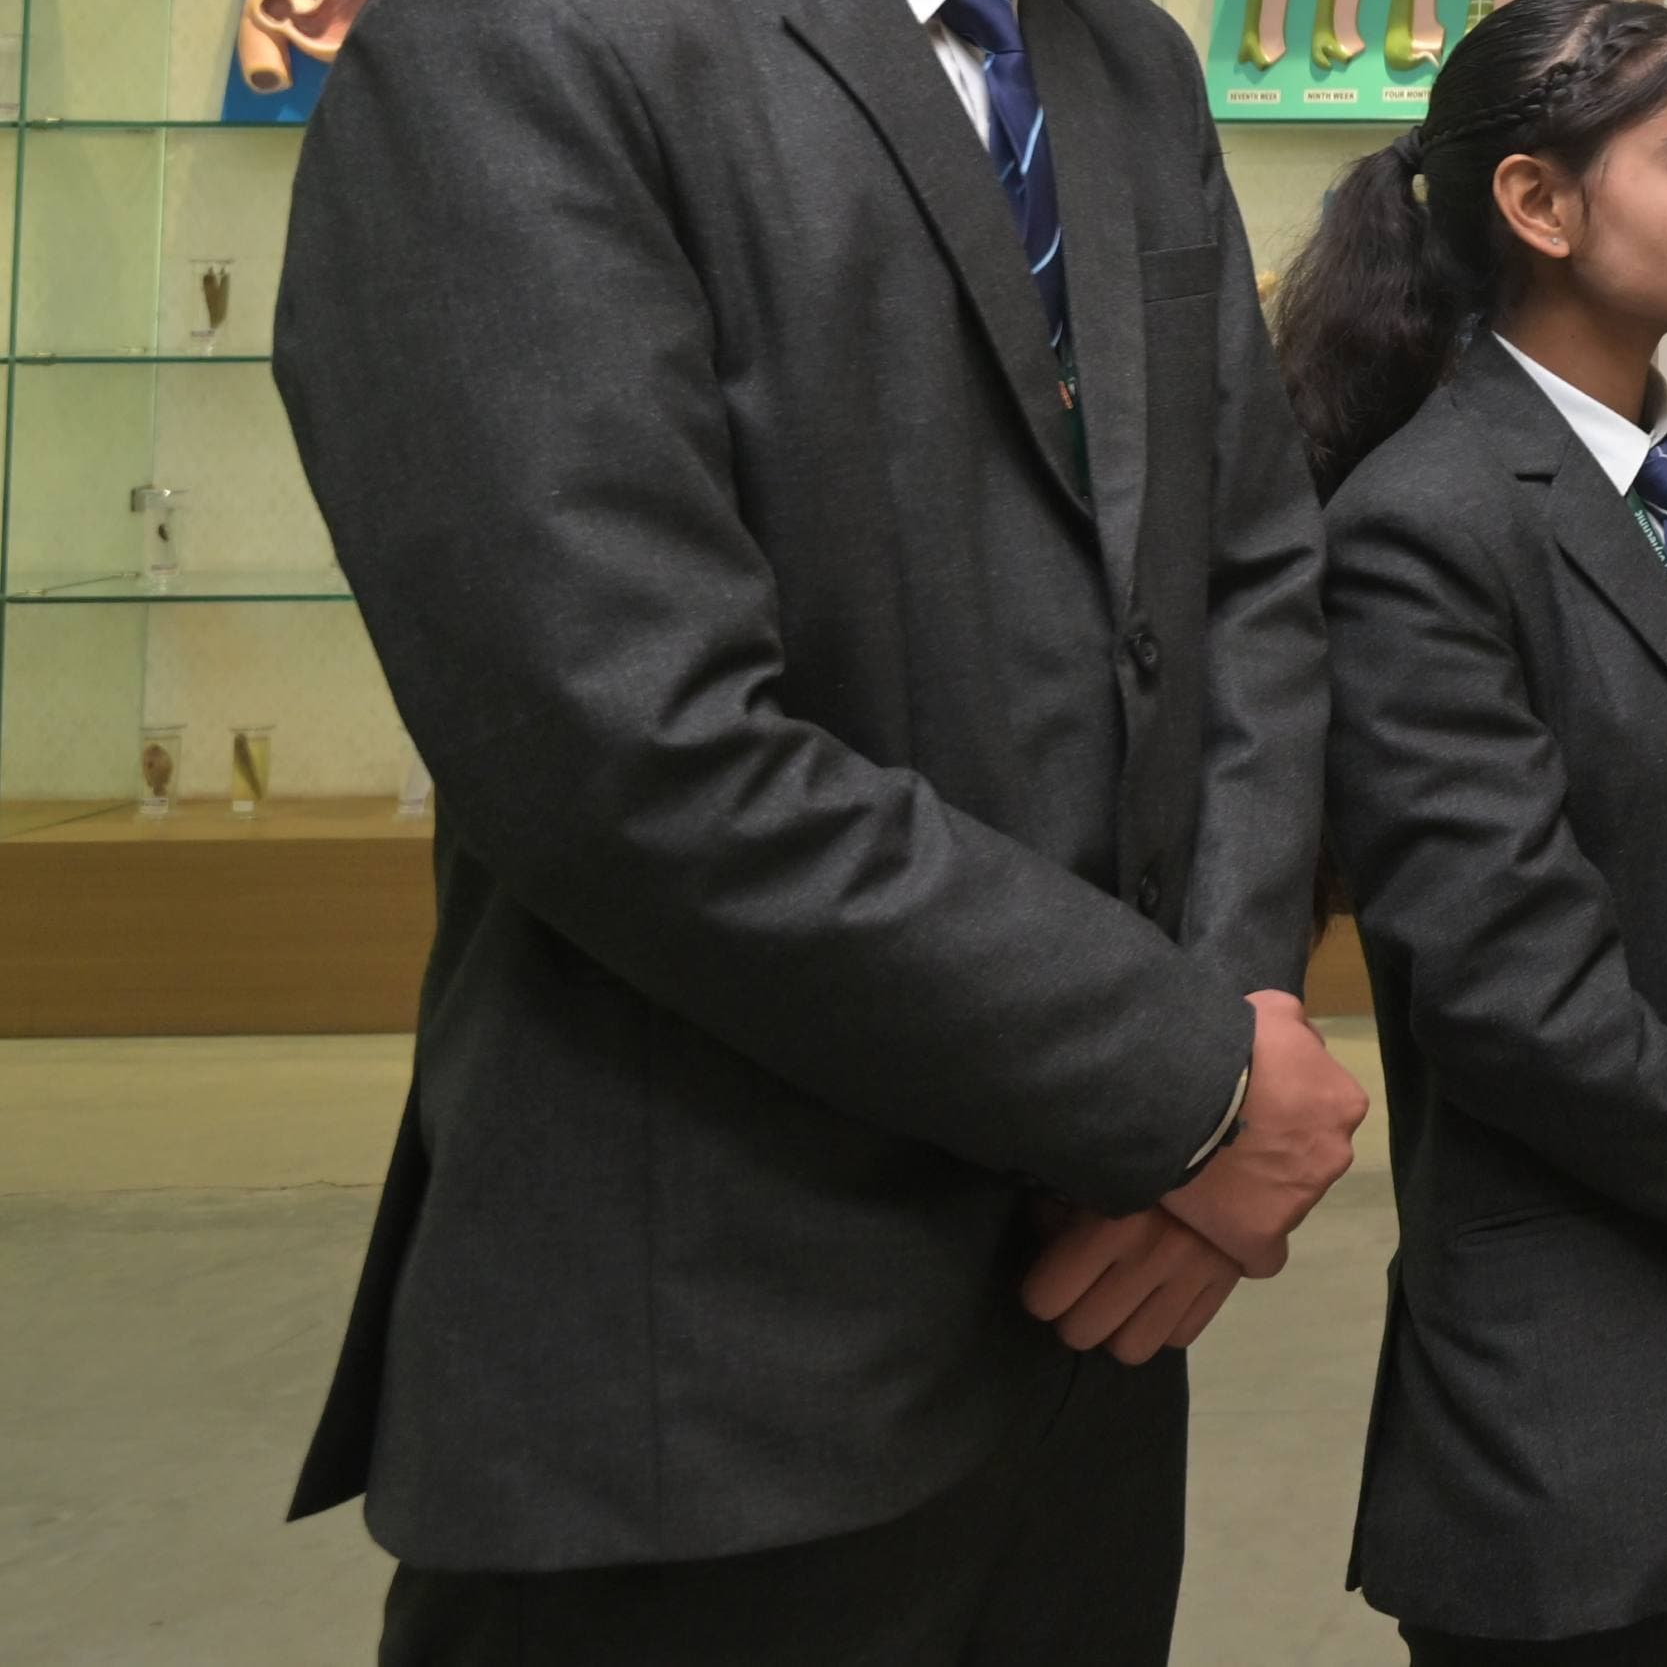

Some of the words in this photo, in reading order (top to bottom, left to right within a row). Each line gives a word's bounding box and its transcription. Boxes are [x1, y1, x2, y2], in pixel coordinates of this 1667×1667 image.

[1230, 92, 1259, 101] SEVENTH
[1260, 92, 1278, 101] WEEK
[1307, 92, 1332, 101] NINTH
[1333, 92, 1355, 101] WEEK
[1384, 90, 1405, 99] FOUR
